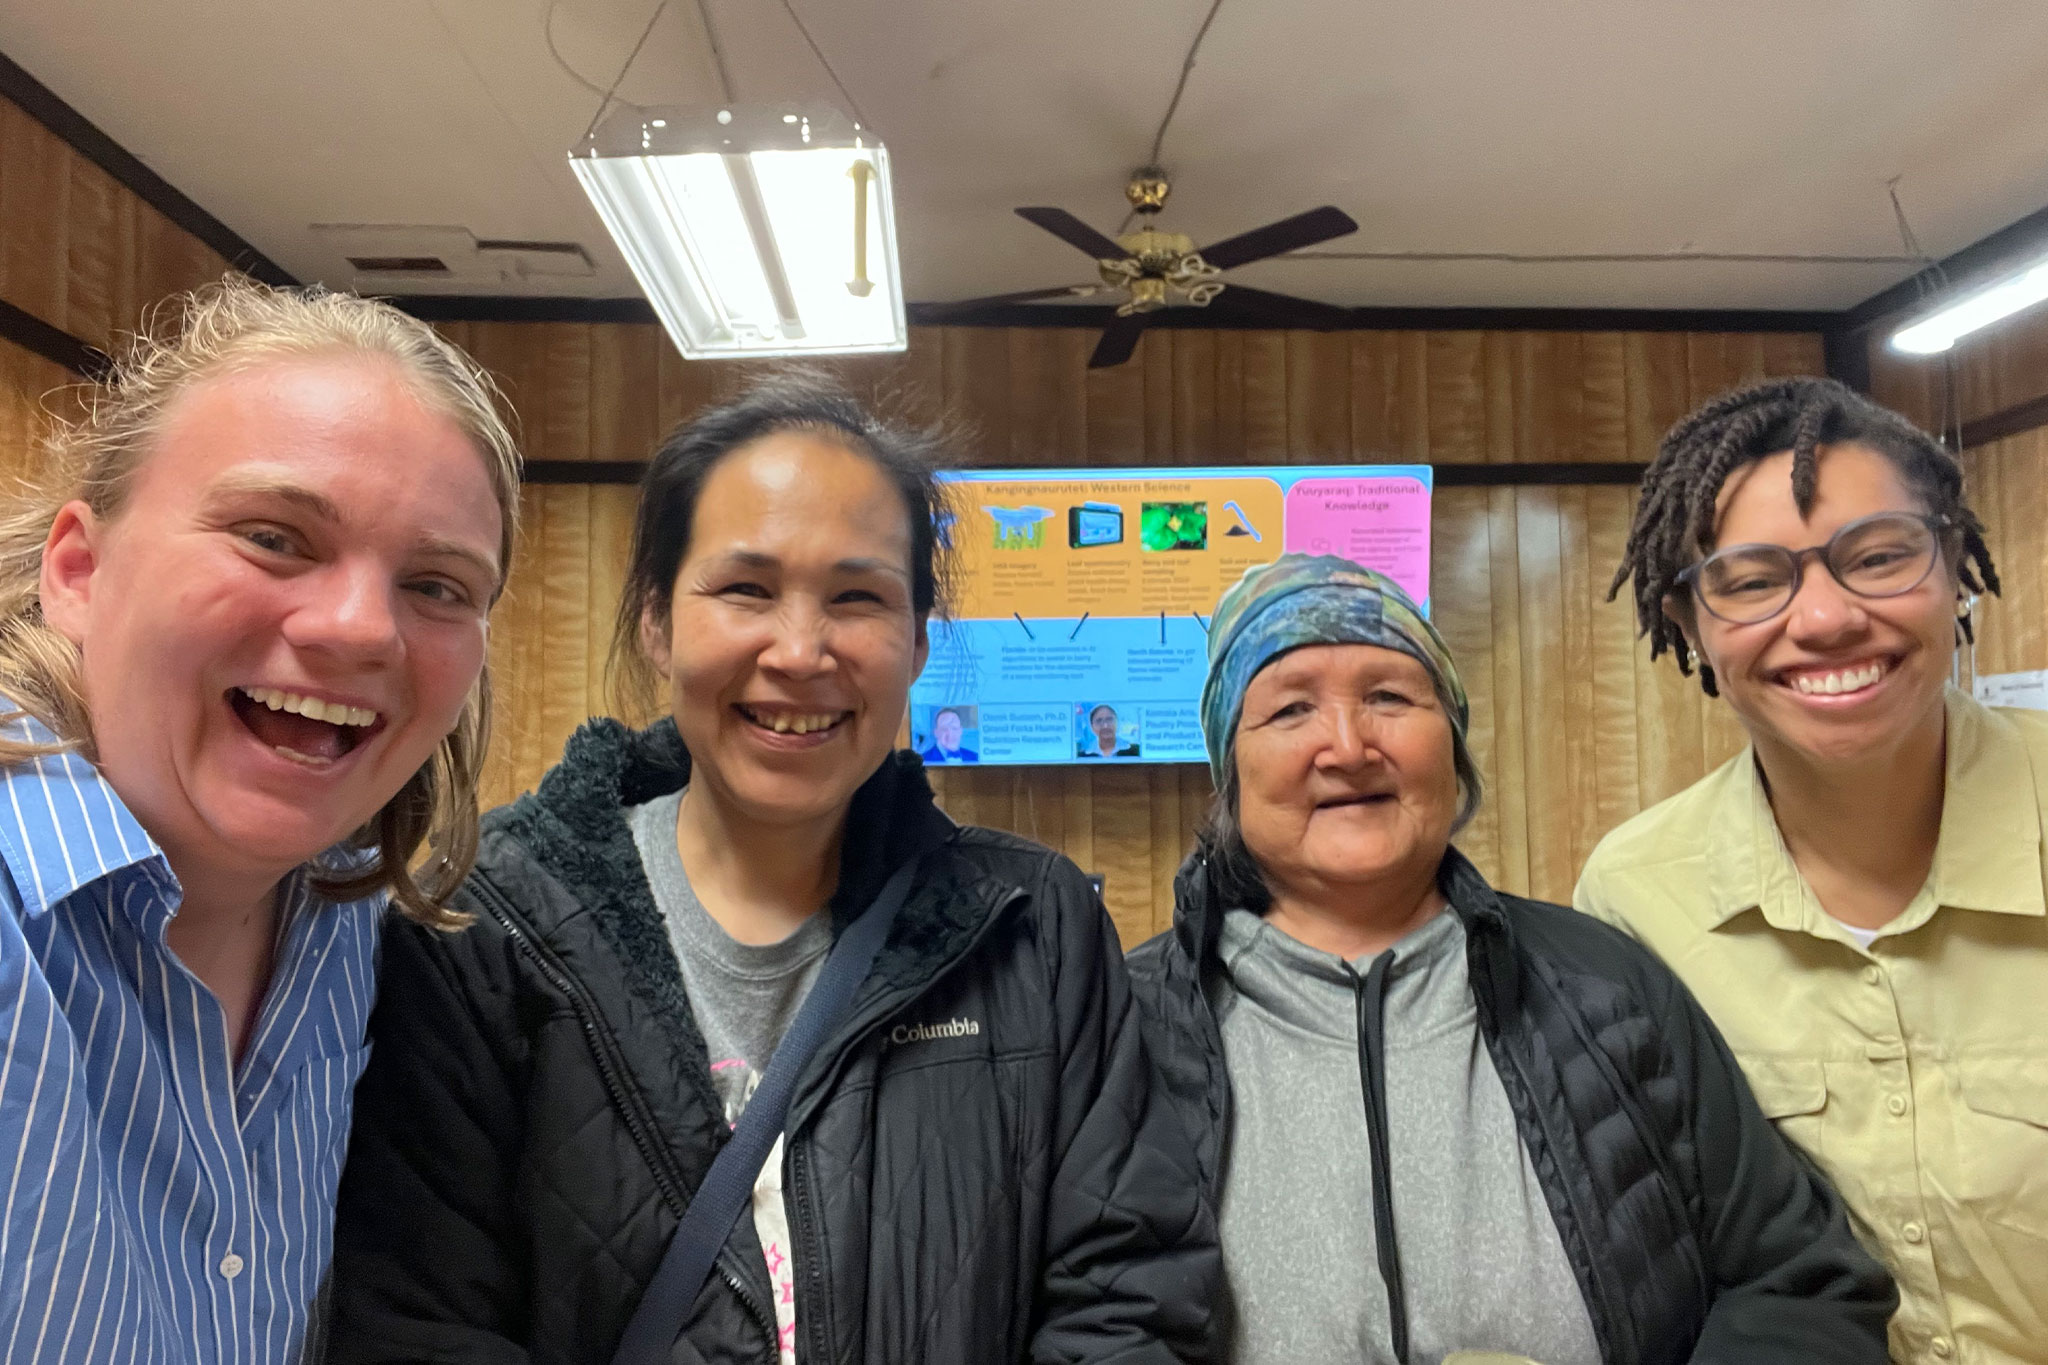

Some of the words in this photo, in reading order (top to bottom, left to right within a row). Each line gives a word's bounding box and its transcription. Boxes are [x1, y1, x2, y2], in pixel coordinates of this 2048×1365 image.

[1091, 481, 1141, 493] Western
[1144, 481, 1190, 493] Science
[1357, 484, 1420, 496] Traditional
[1324, 500, 1390, 512] Knowledge
[1035, 723, 1067, 733] Human
[1021, 735, 1062, 744] Research
[1145, 742, 1184, 751] Research
[891, 1017, 979, 1044] Columbia
